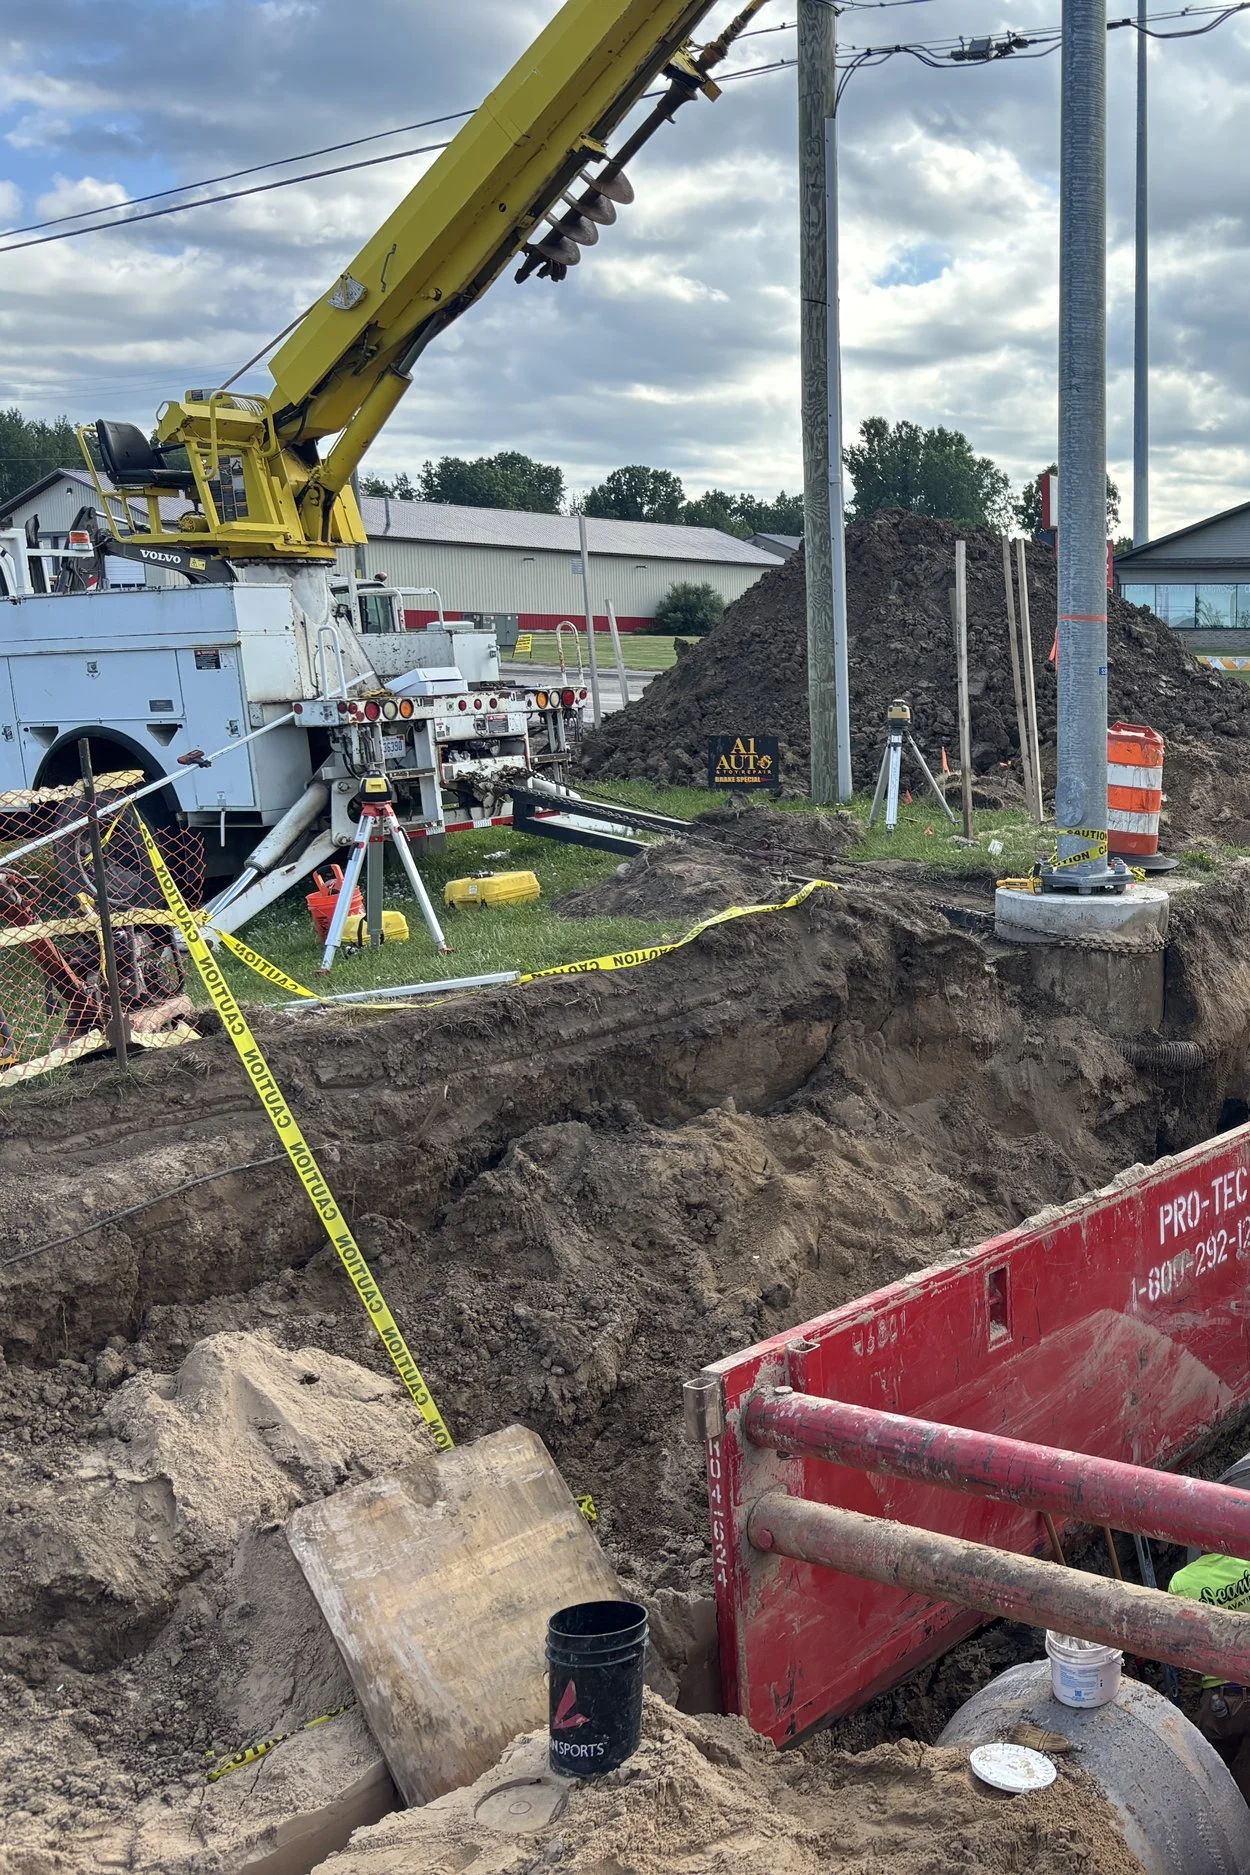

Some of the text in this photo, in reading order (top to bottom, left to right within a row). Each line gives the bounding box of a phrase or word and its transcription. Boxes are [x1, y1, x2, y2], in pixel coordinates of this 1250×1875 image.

[140, 549, 181, 564] VOLVO
[716, 754, 773, 770] AUTO
[1160, 1166, 1248, 1245] PRO-TEC
